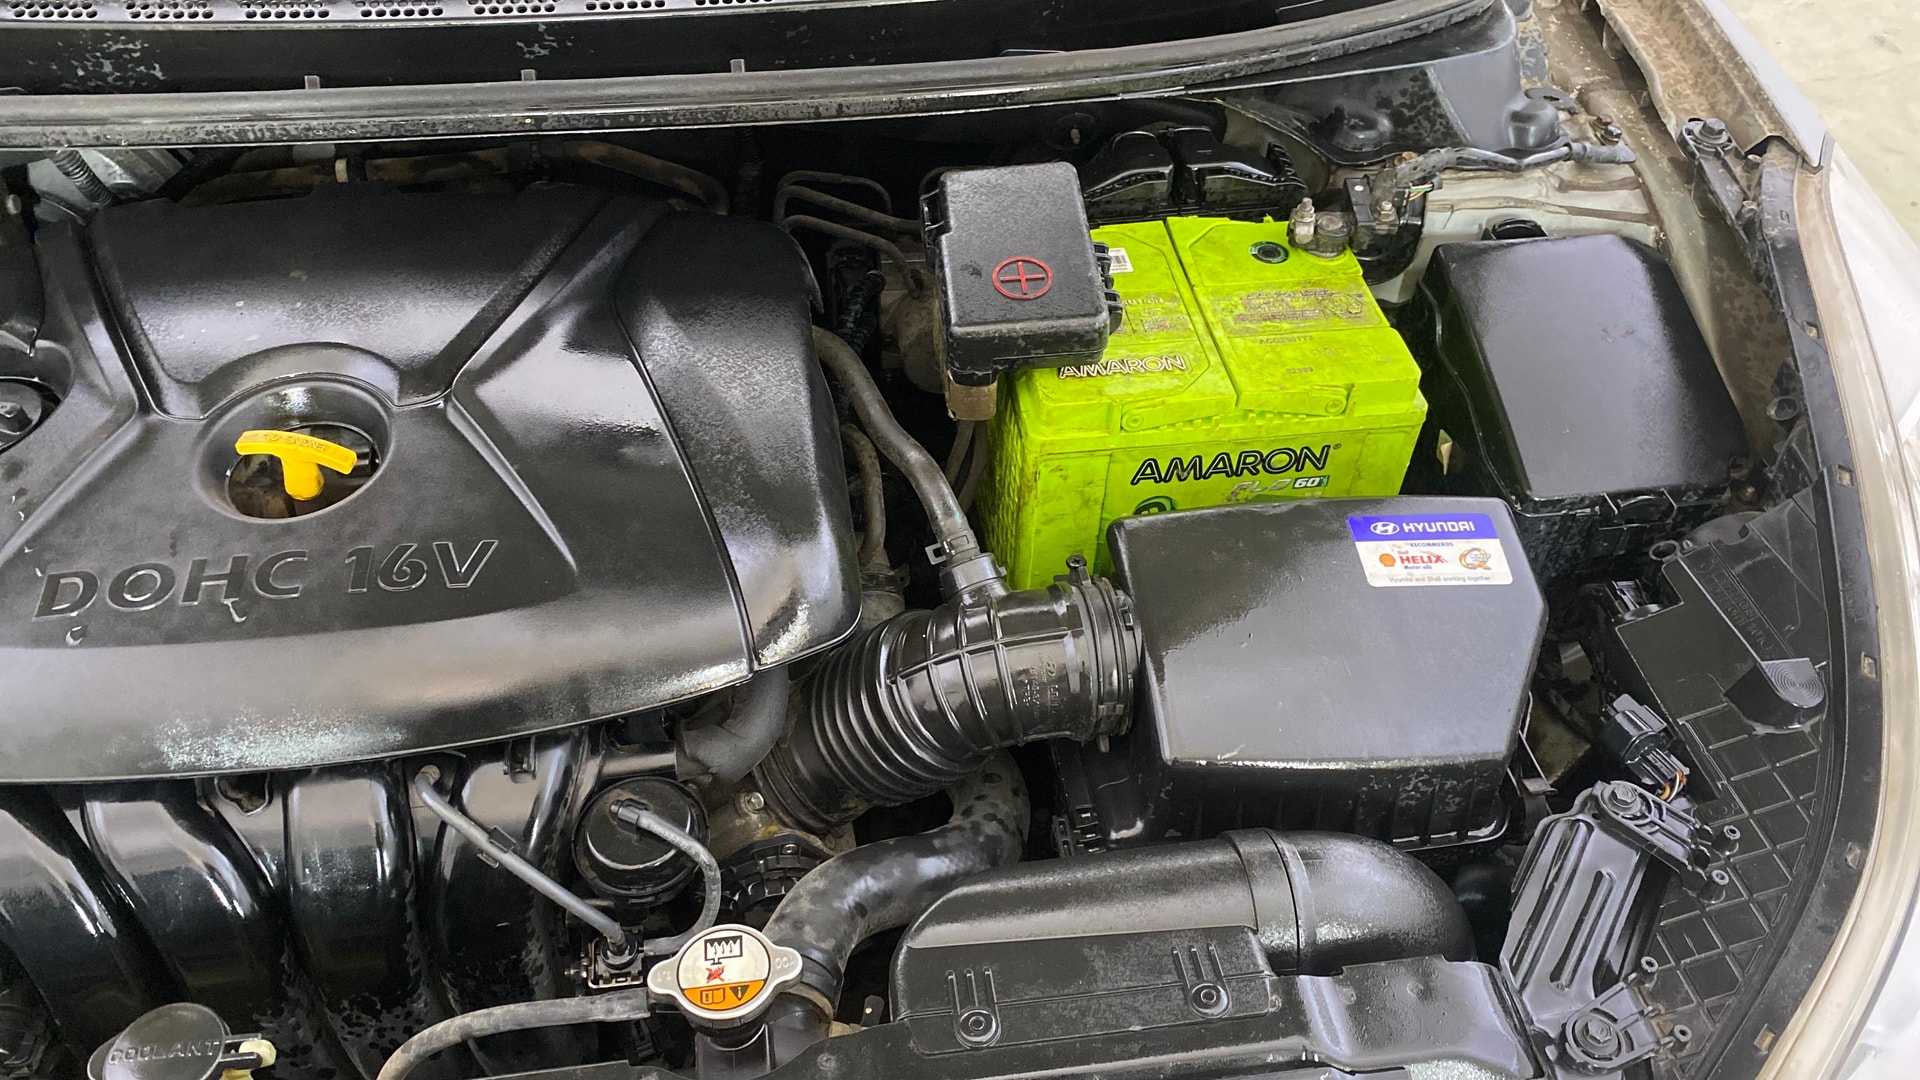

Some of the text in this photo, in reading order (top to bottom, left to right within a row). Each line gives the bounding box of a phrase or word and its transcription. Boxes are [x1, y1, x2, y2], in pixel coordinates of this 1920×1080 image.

[1059, 354, 1187, 379] AMARON
[1130, 444, 1331, 486] AMARON
[1402, 521, 1476, 533] HYUNDAI
[1400, 555, 1446, 564] HELIX
[32, 539, 499, 621] DOHC 16V
[108, 1039, 220, 1065] COOLANT
